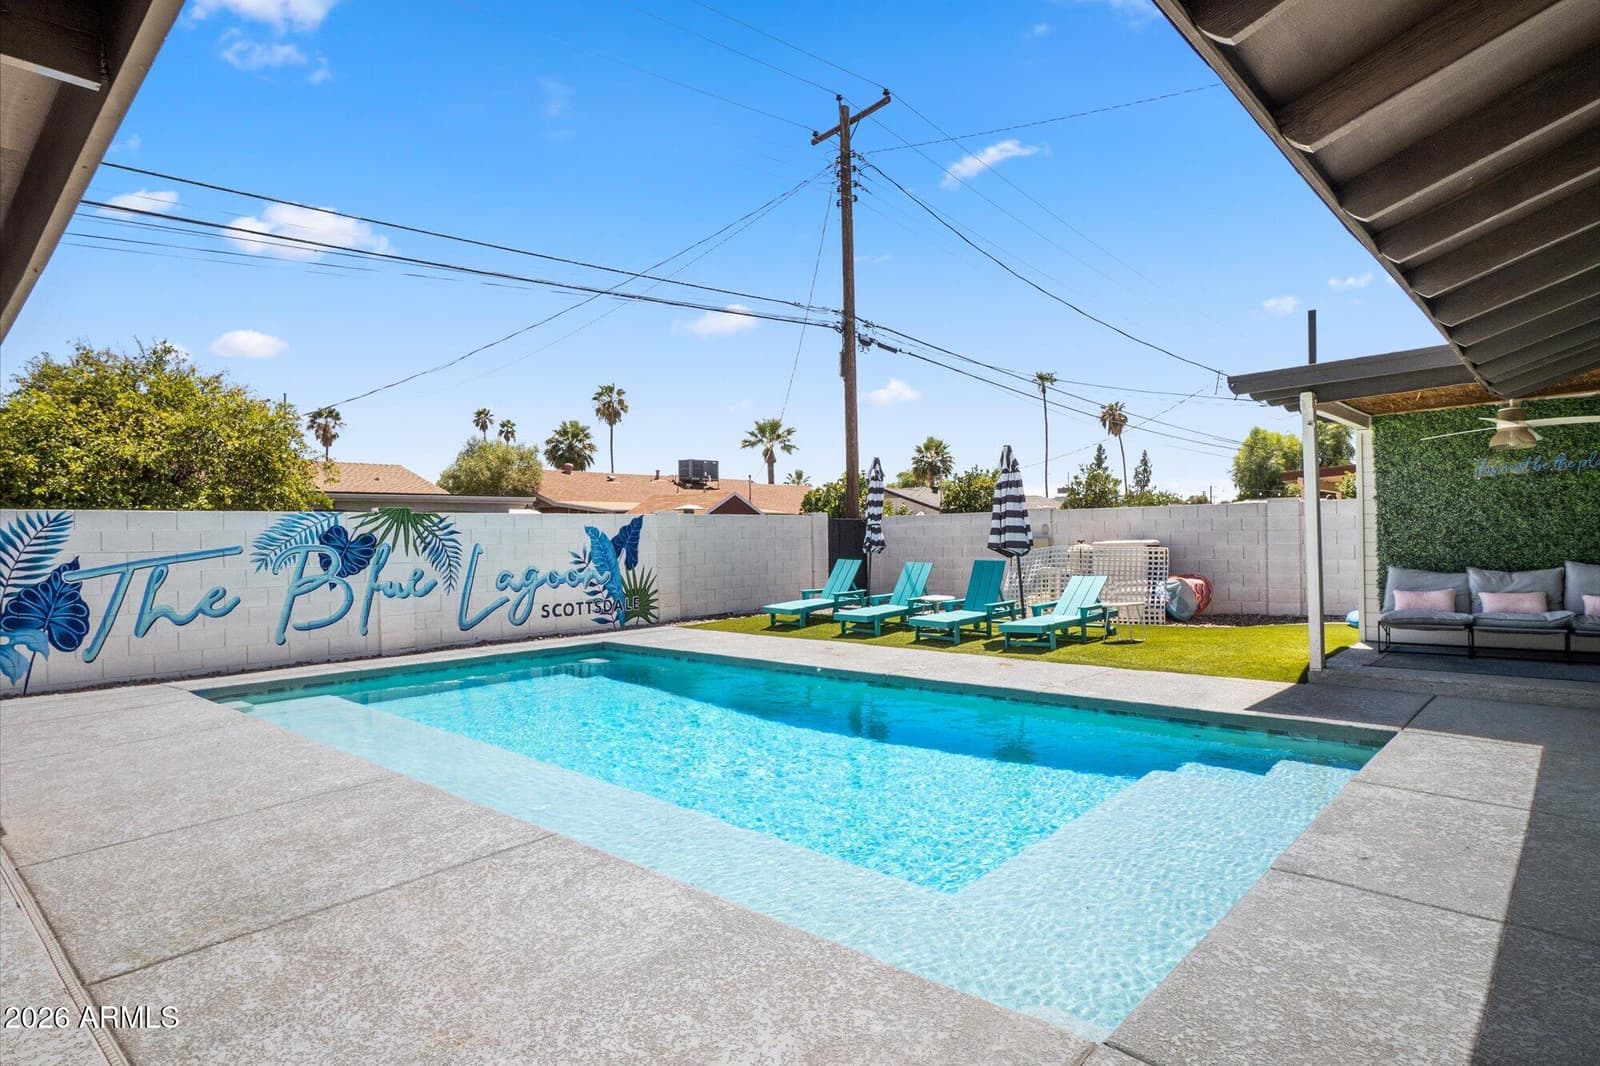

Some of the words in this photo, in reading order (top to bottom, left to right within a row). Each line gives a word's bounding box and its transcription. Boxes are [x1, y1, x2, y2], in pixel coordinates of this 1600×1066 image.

[62, 545, 244, 663] The
[272, 541, 438, 646] Blue
[457, 543, 612, 632] Lagoon
[541, 596, 641, 619] SCOTTSDALE
